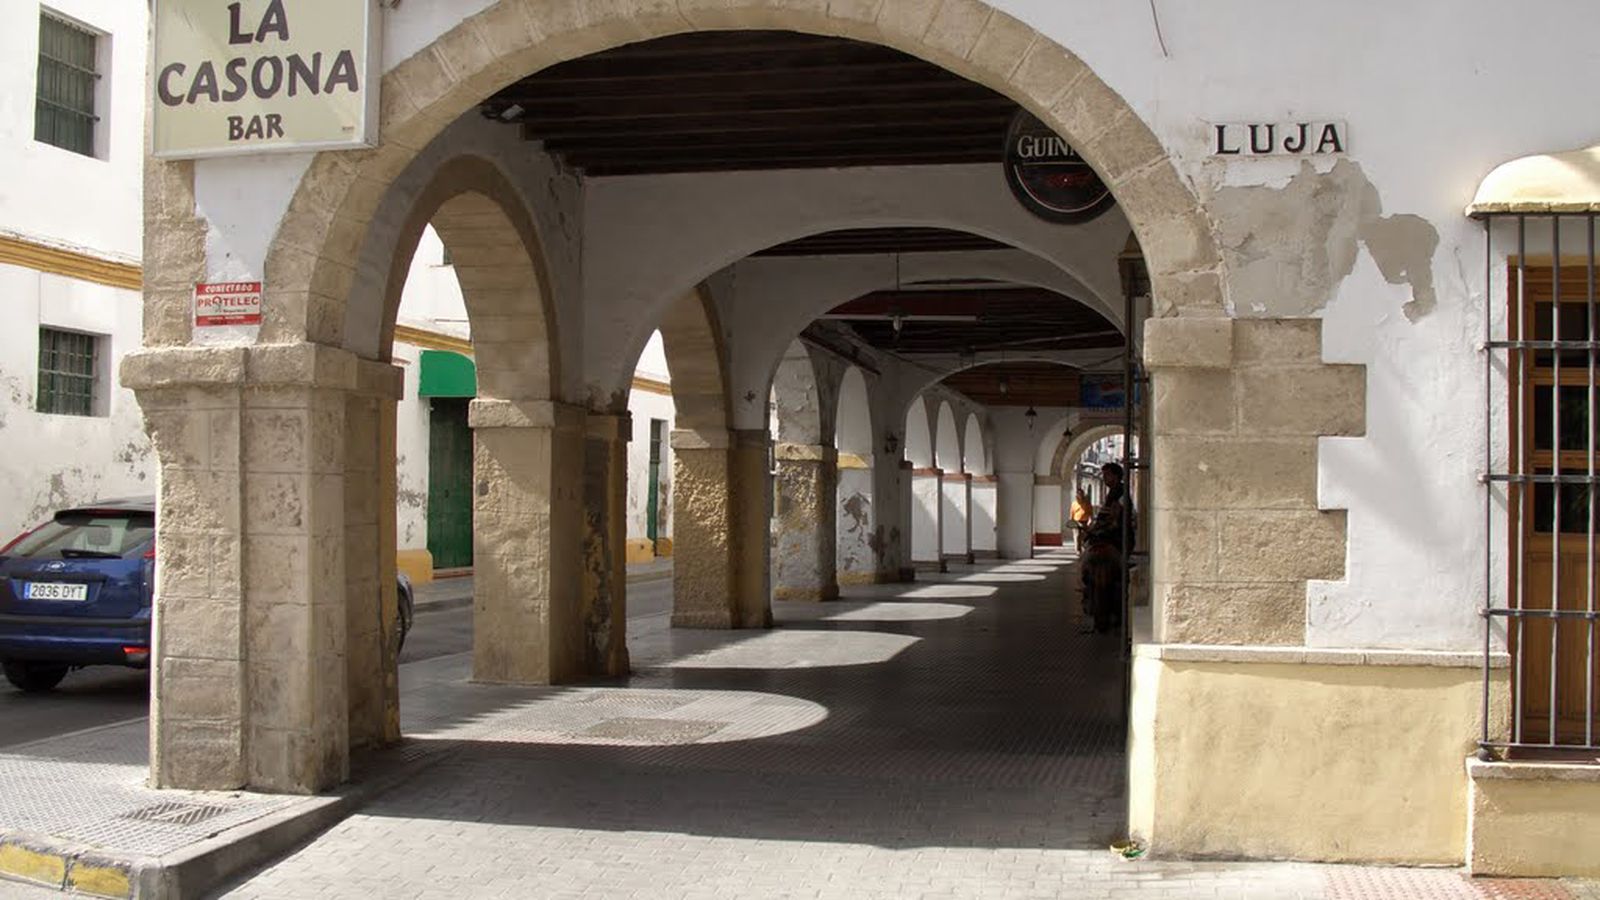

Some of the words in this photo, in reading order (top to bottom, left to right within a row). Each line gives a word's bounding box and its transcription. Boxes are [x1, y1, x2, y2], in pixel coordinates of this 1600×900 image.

[227, 0, 289, 44] LA
[157, 50, 359, 106] CASONA
[227, 114, 284, 140] BAR
[1215, 123, 1344, 154] LUJA
[1017, 135, 1075, 158] GUIN
[198, 296, 259, 307] PROTELEC
